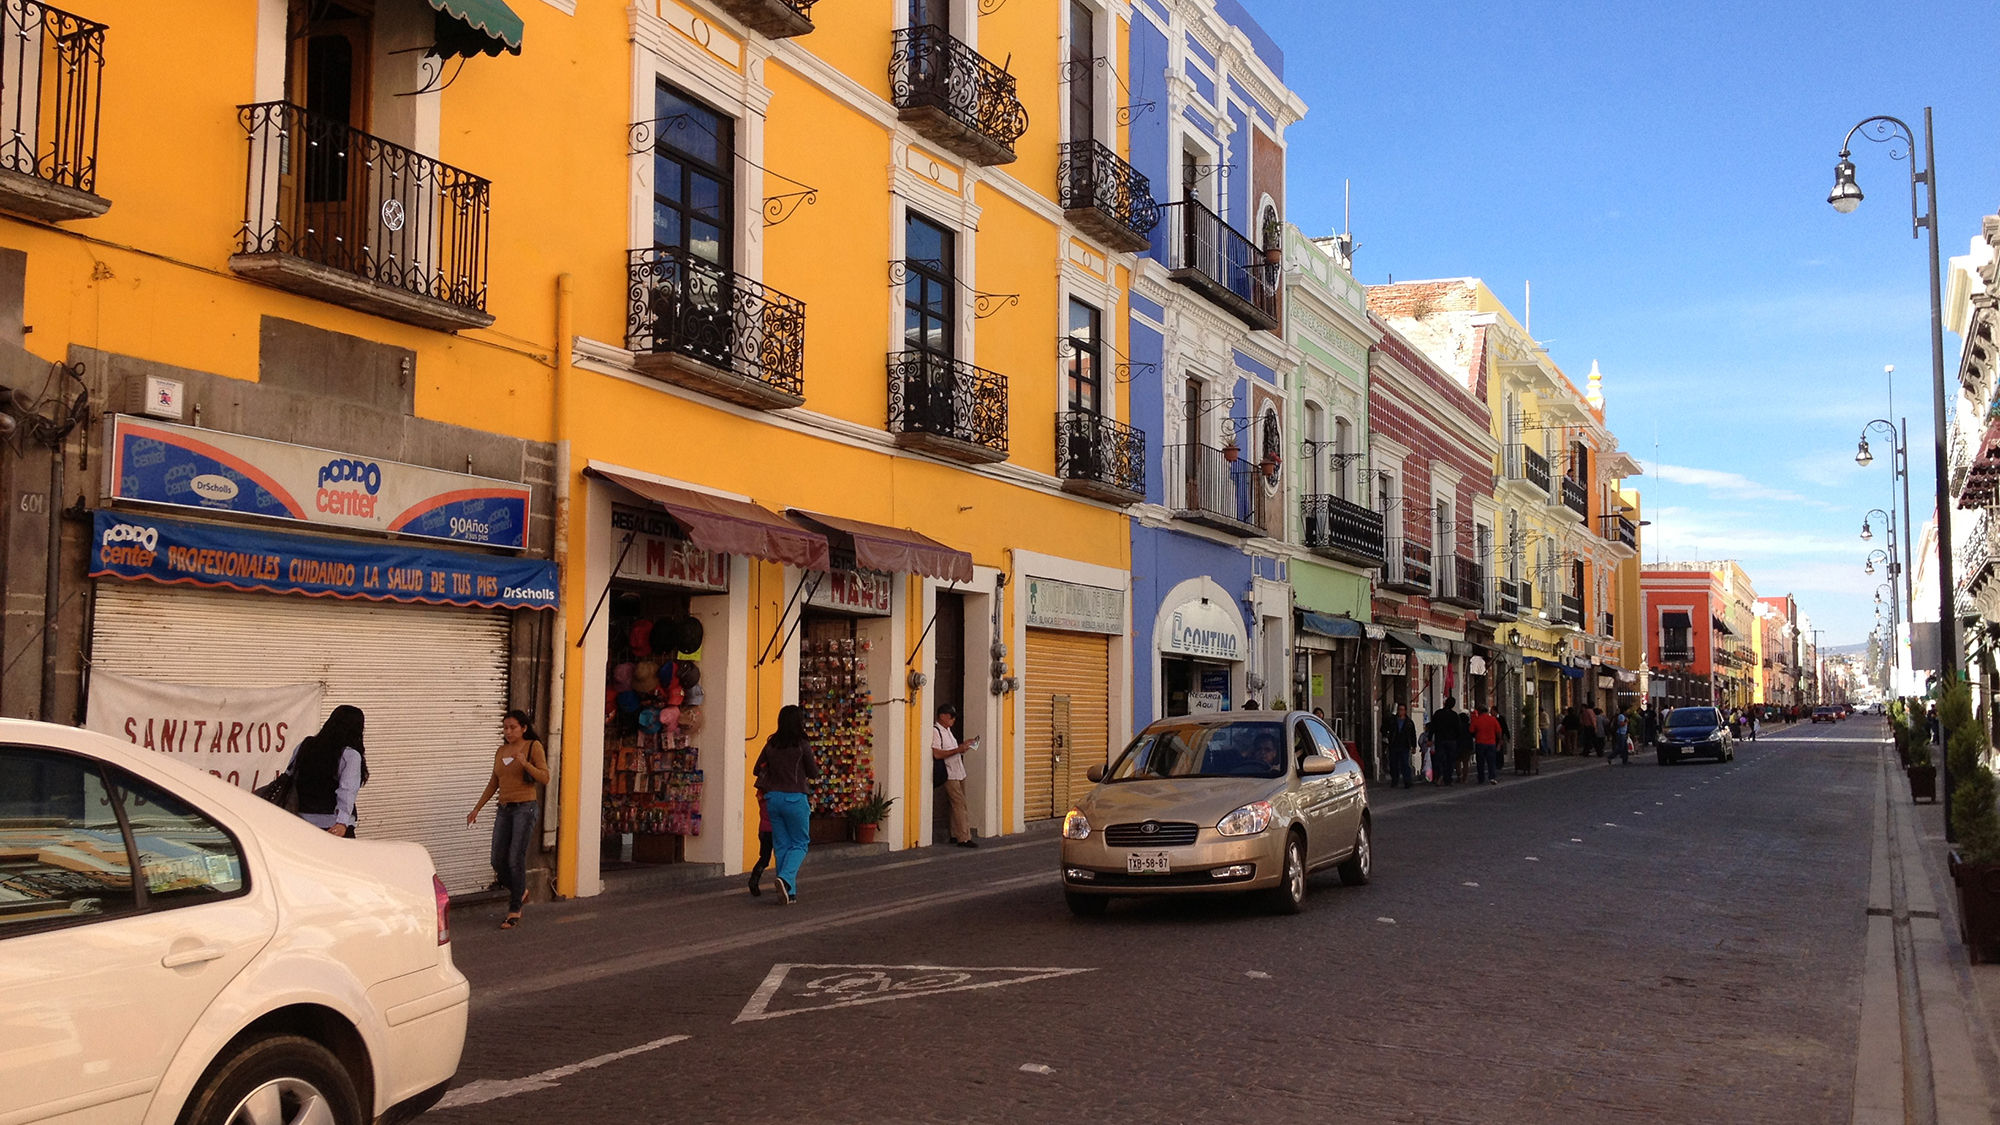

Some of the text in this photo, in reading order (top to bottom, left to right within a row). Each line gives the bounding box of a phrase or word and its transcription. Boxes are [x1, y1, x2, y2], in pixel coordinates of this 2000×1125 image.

[21, 494, 43, 513] 601
[316, 488, 378, 518] center
[100, 545, 158, 568] center
[168, 545, 555, 600] PROFESIONALES CUIDANDO LA SALUD DE TUS PIES DrScholls
[124, 717, 288, 753] SANITARIOS
